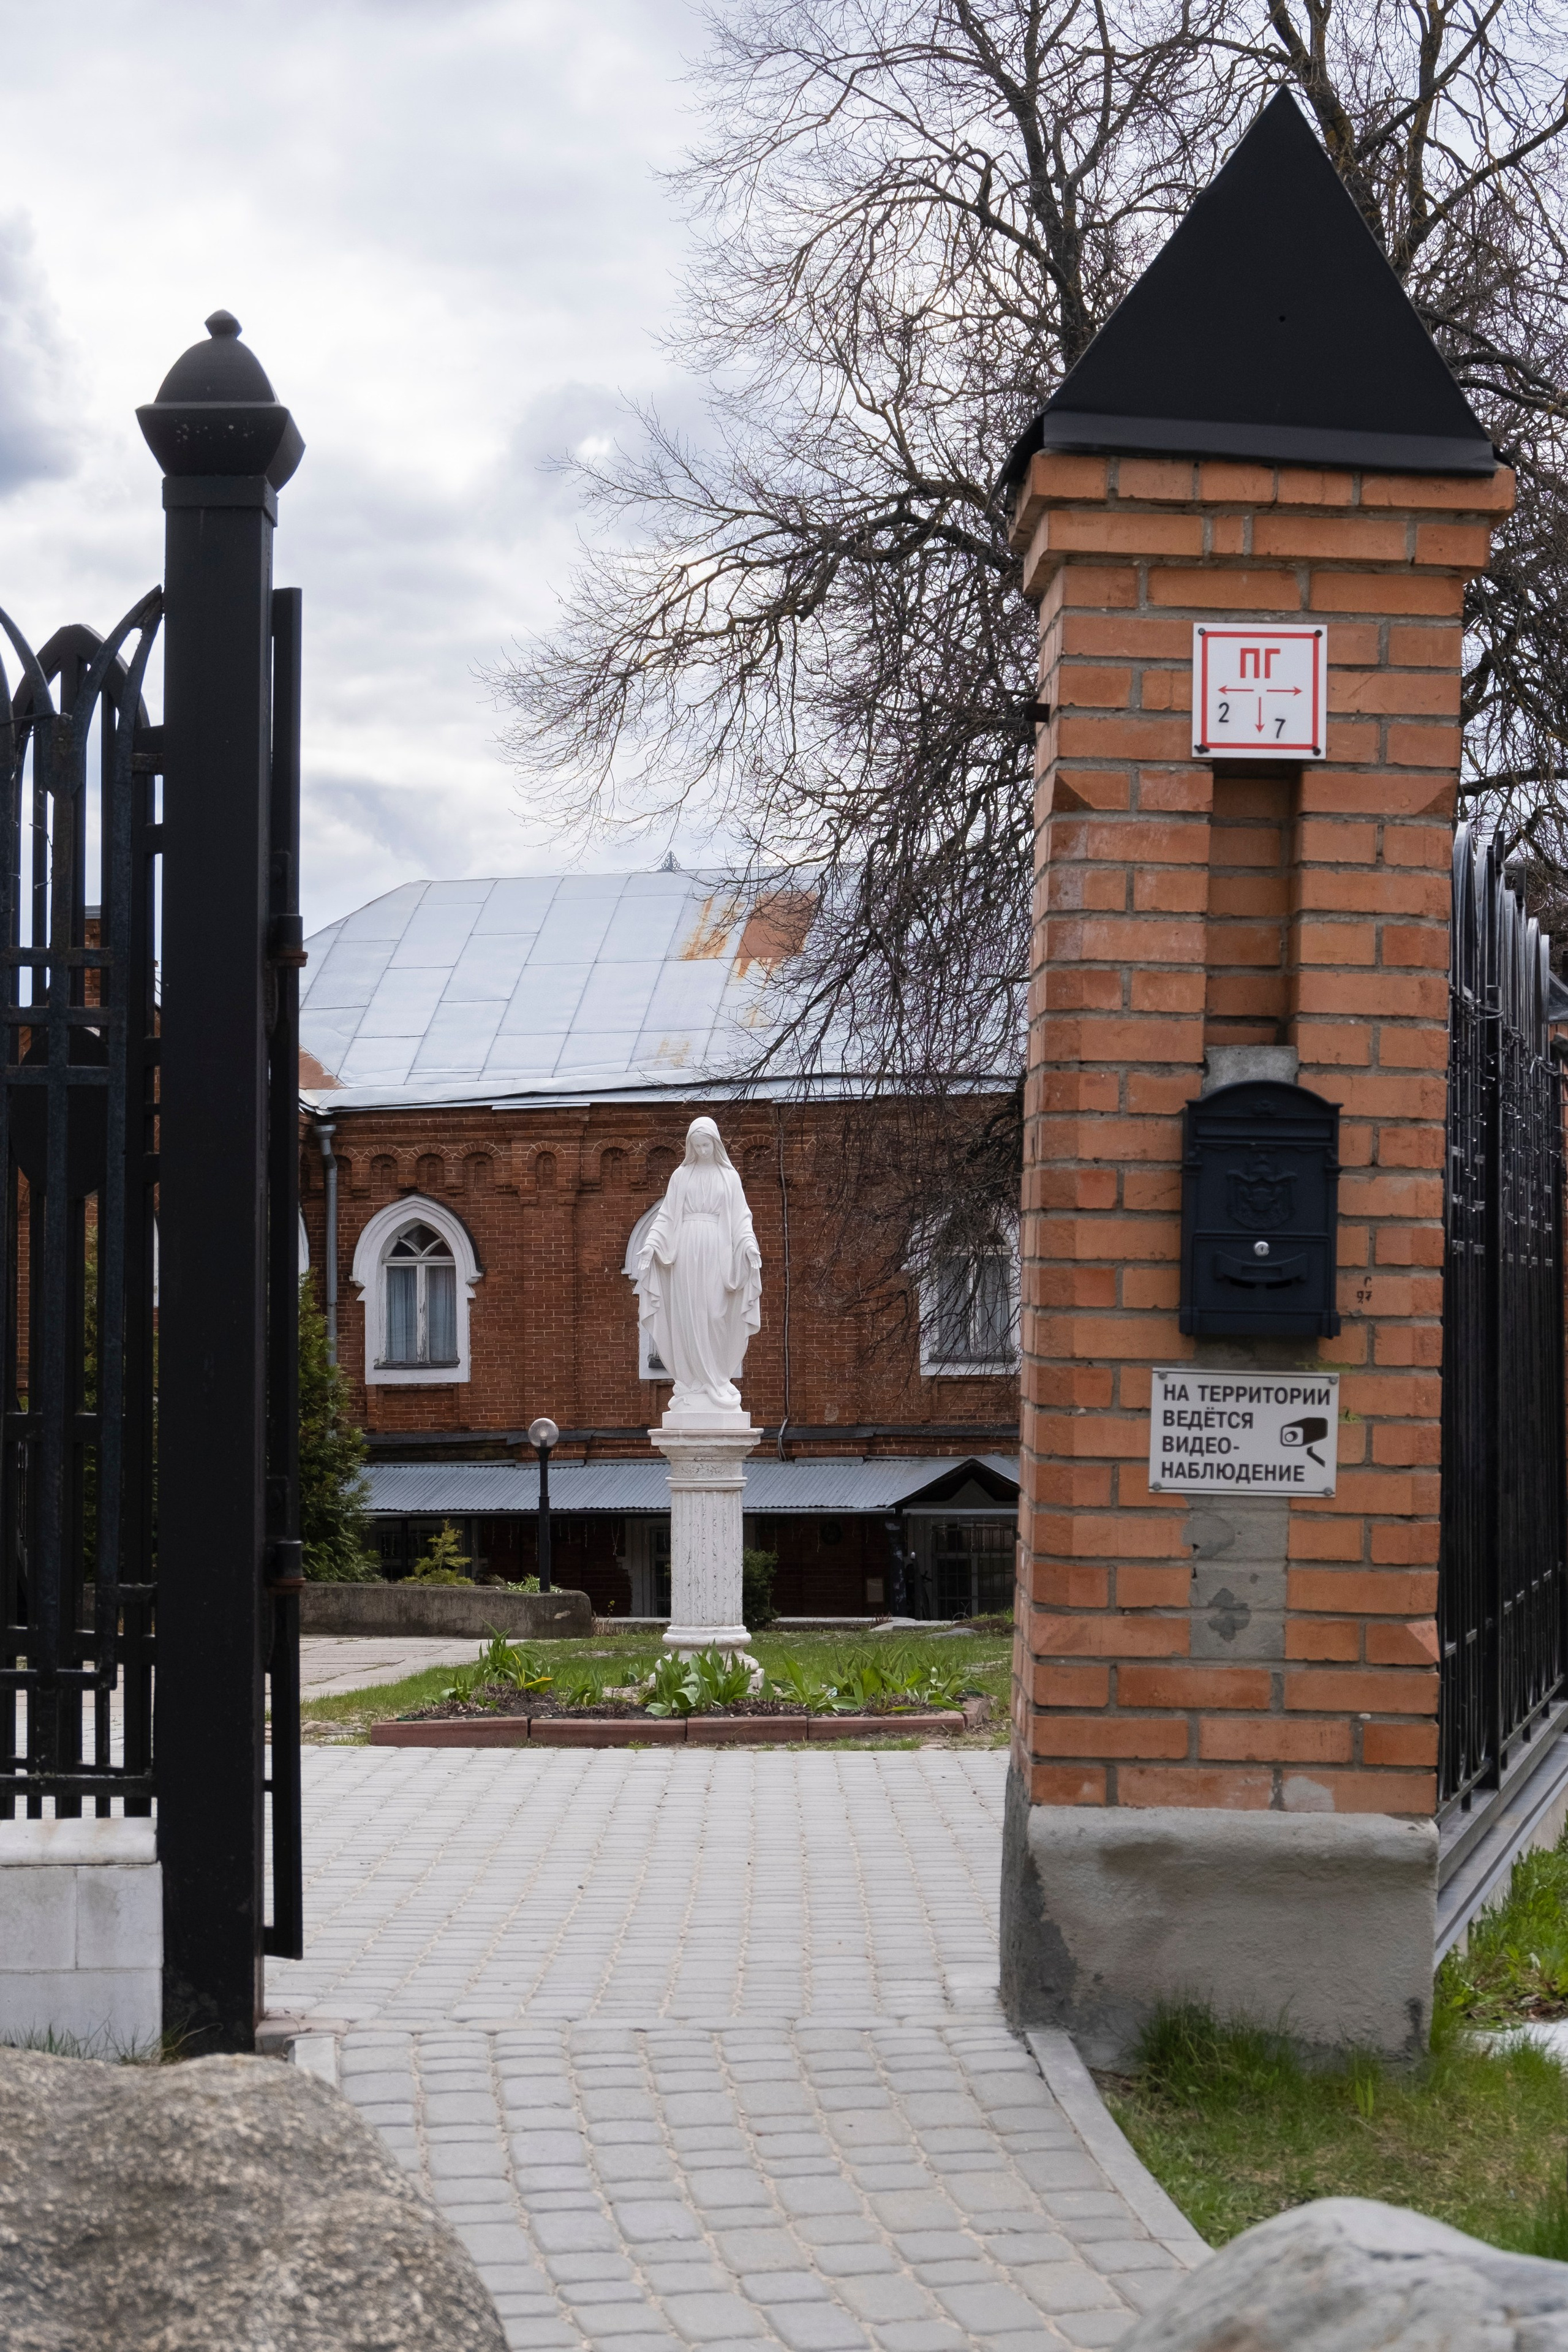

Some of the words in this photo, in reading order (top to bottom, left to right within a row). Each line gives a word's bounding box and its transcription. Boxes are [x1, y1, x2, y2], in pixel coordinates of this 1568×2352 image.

[1240, 648, 1281, 679] ПГ
[1218, 702, 1230, 723] 2
[1275, 718, 1286, 739] 7
[1164, 1384, 1189, 1401] НА
[1197, 1385, 1330, 1406] ТЕРРИТОРИИ
[1163, 1407, 1254, 1431] ВЕДЁТСЯ
[1163, 1436, 1240, 1457] ВИДЕО-
[1161, 1461, 1305, 1484] НАБЛЮДЕНИЕ
